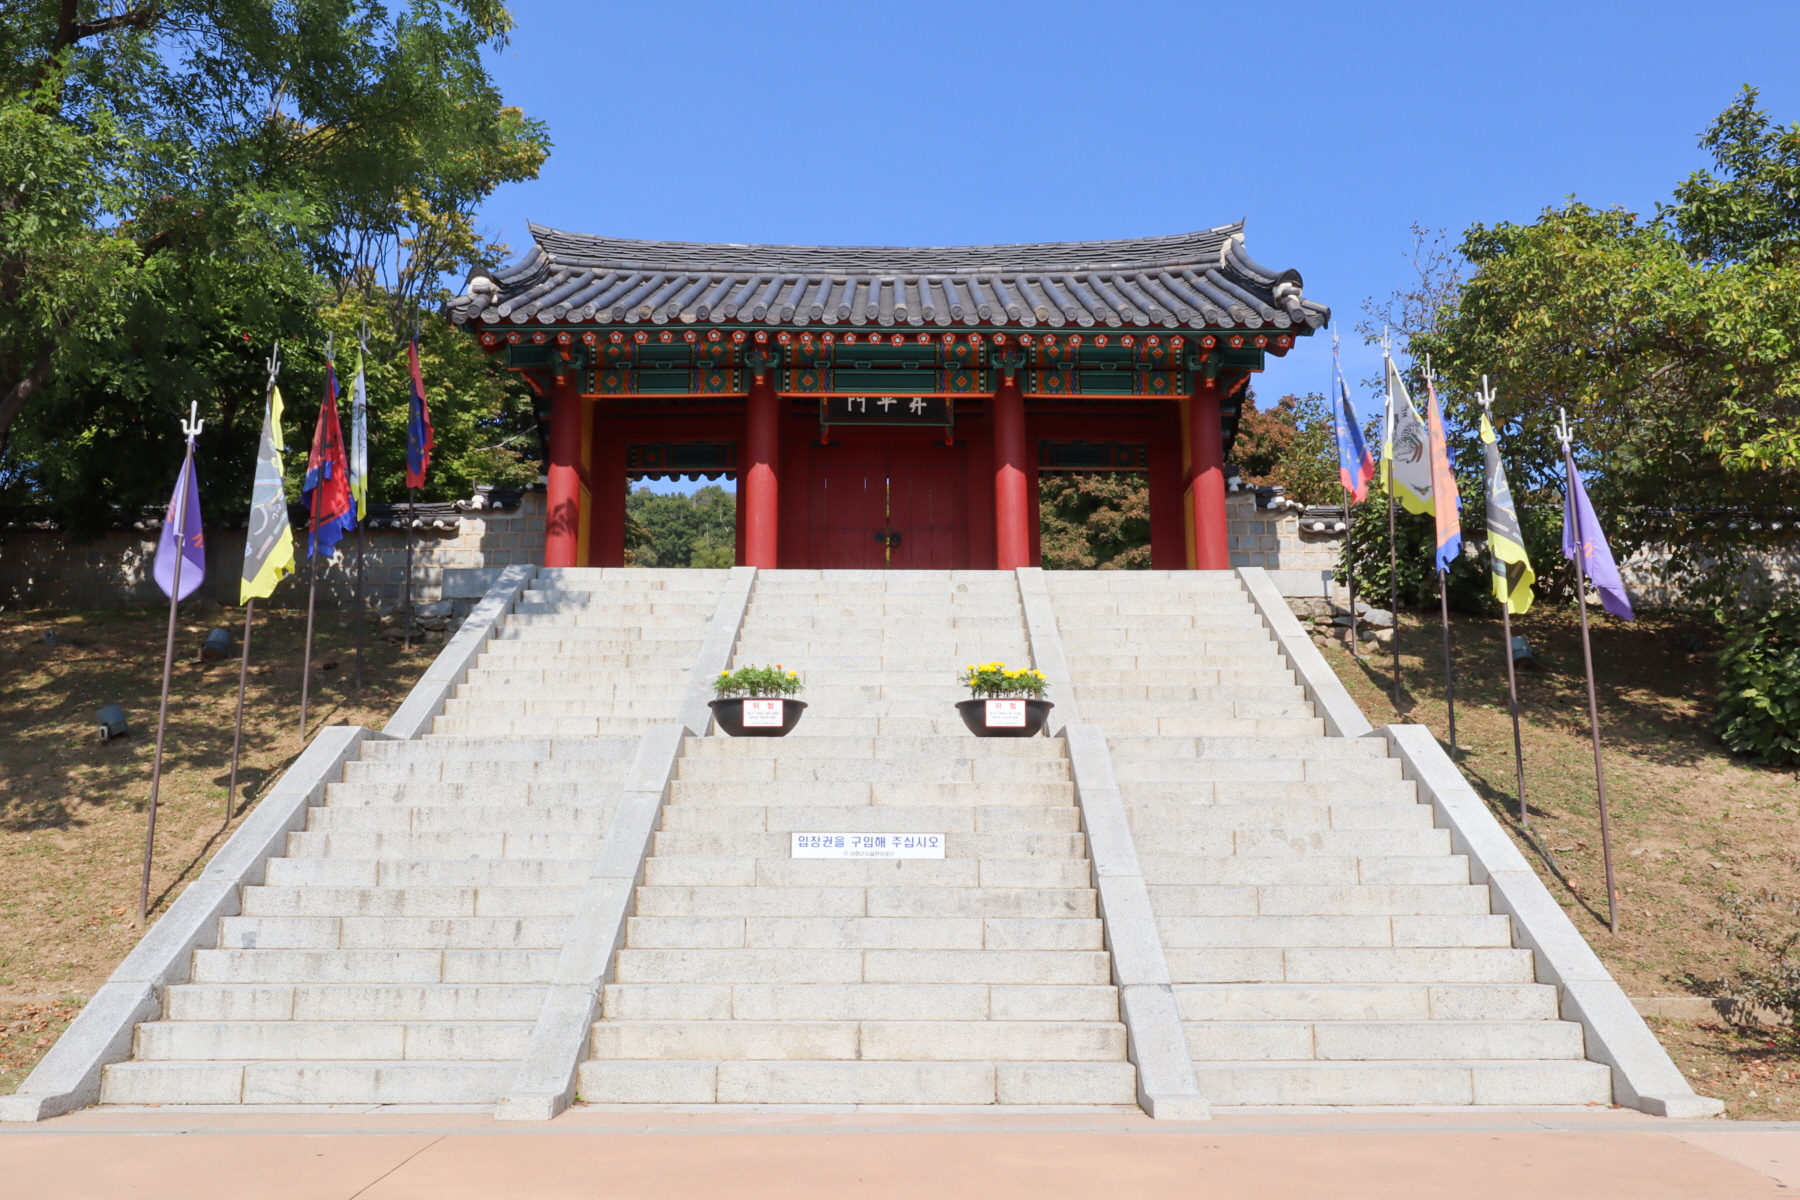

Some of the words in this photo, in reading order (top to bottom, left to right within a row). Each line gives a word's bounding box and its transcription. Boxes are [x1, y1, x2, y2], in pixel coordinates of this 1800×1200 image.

[798, 835, 845, 848] 입장권을
[851, 836, 886, 848] 구입해
[891, 836, 939, 848] 주십시오
